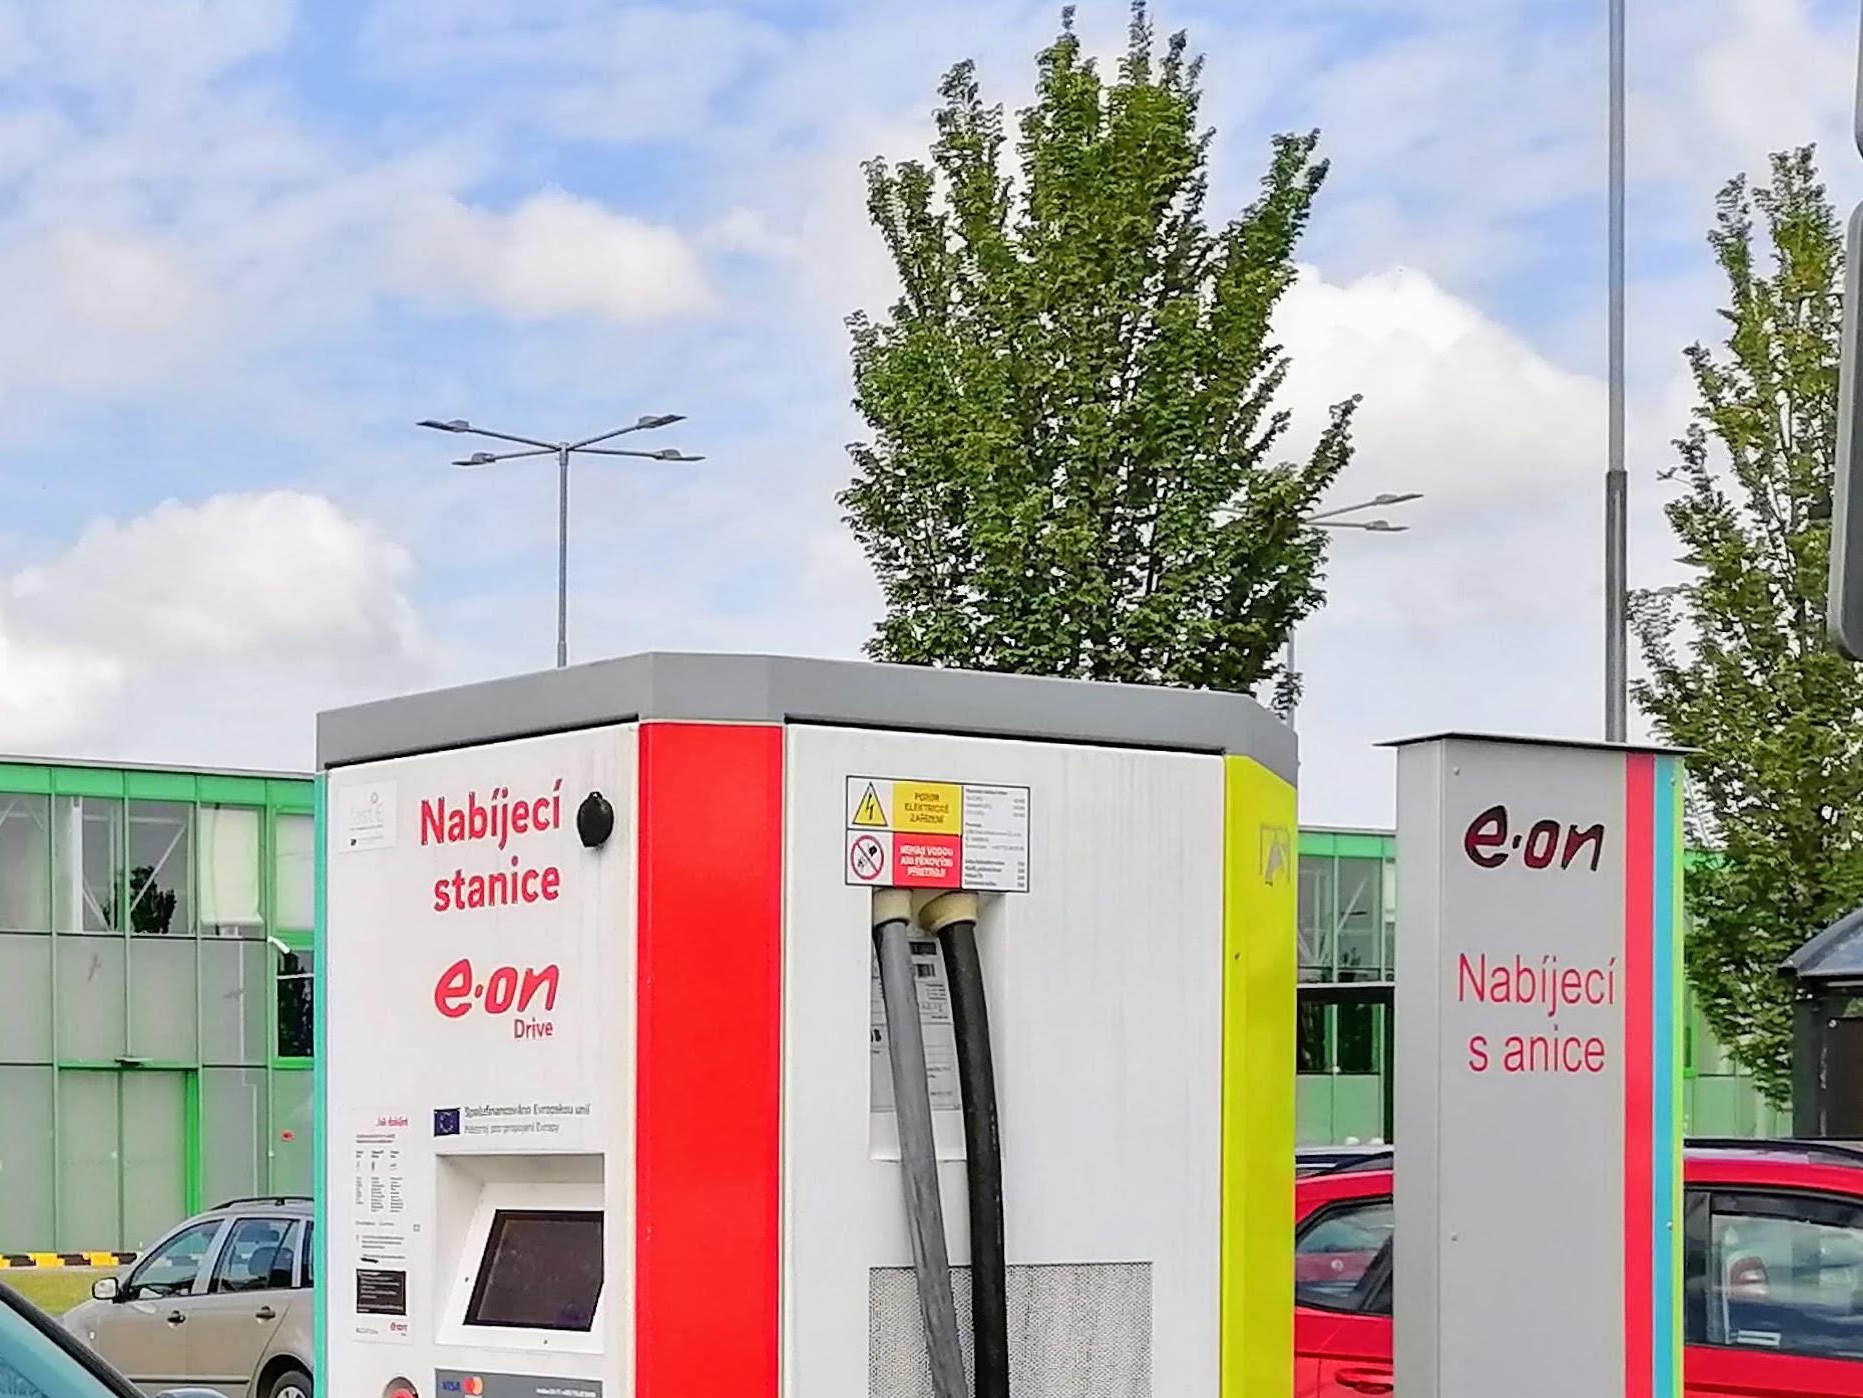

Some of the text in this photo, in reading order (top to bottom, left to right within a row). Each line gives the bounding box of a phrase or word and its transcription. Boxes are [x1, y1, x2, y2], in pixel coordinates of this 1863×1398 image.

[420, 778, 563, 850] Nabíjecí
[434, 855, 560, 912] stanice
[1458, 953, 1616, 1017] Nabíjecí
[514, 1017, 554, 1039] Drive
